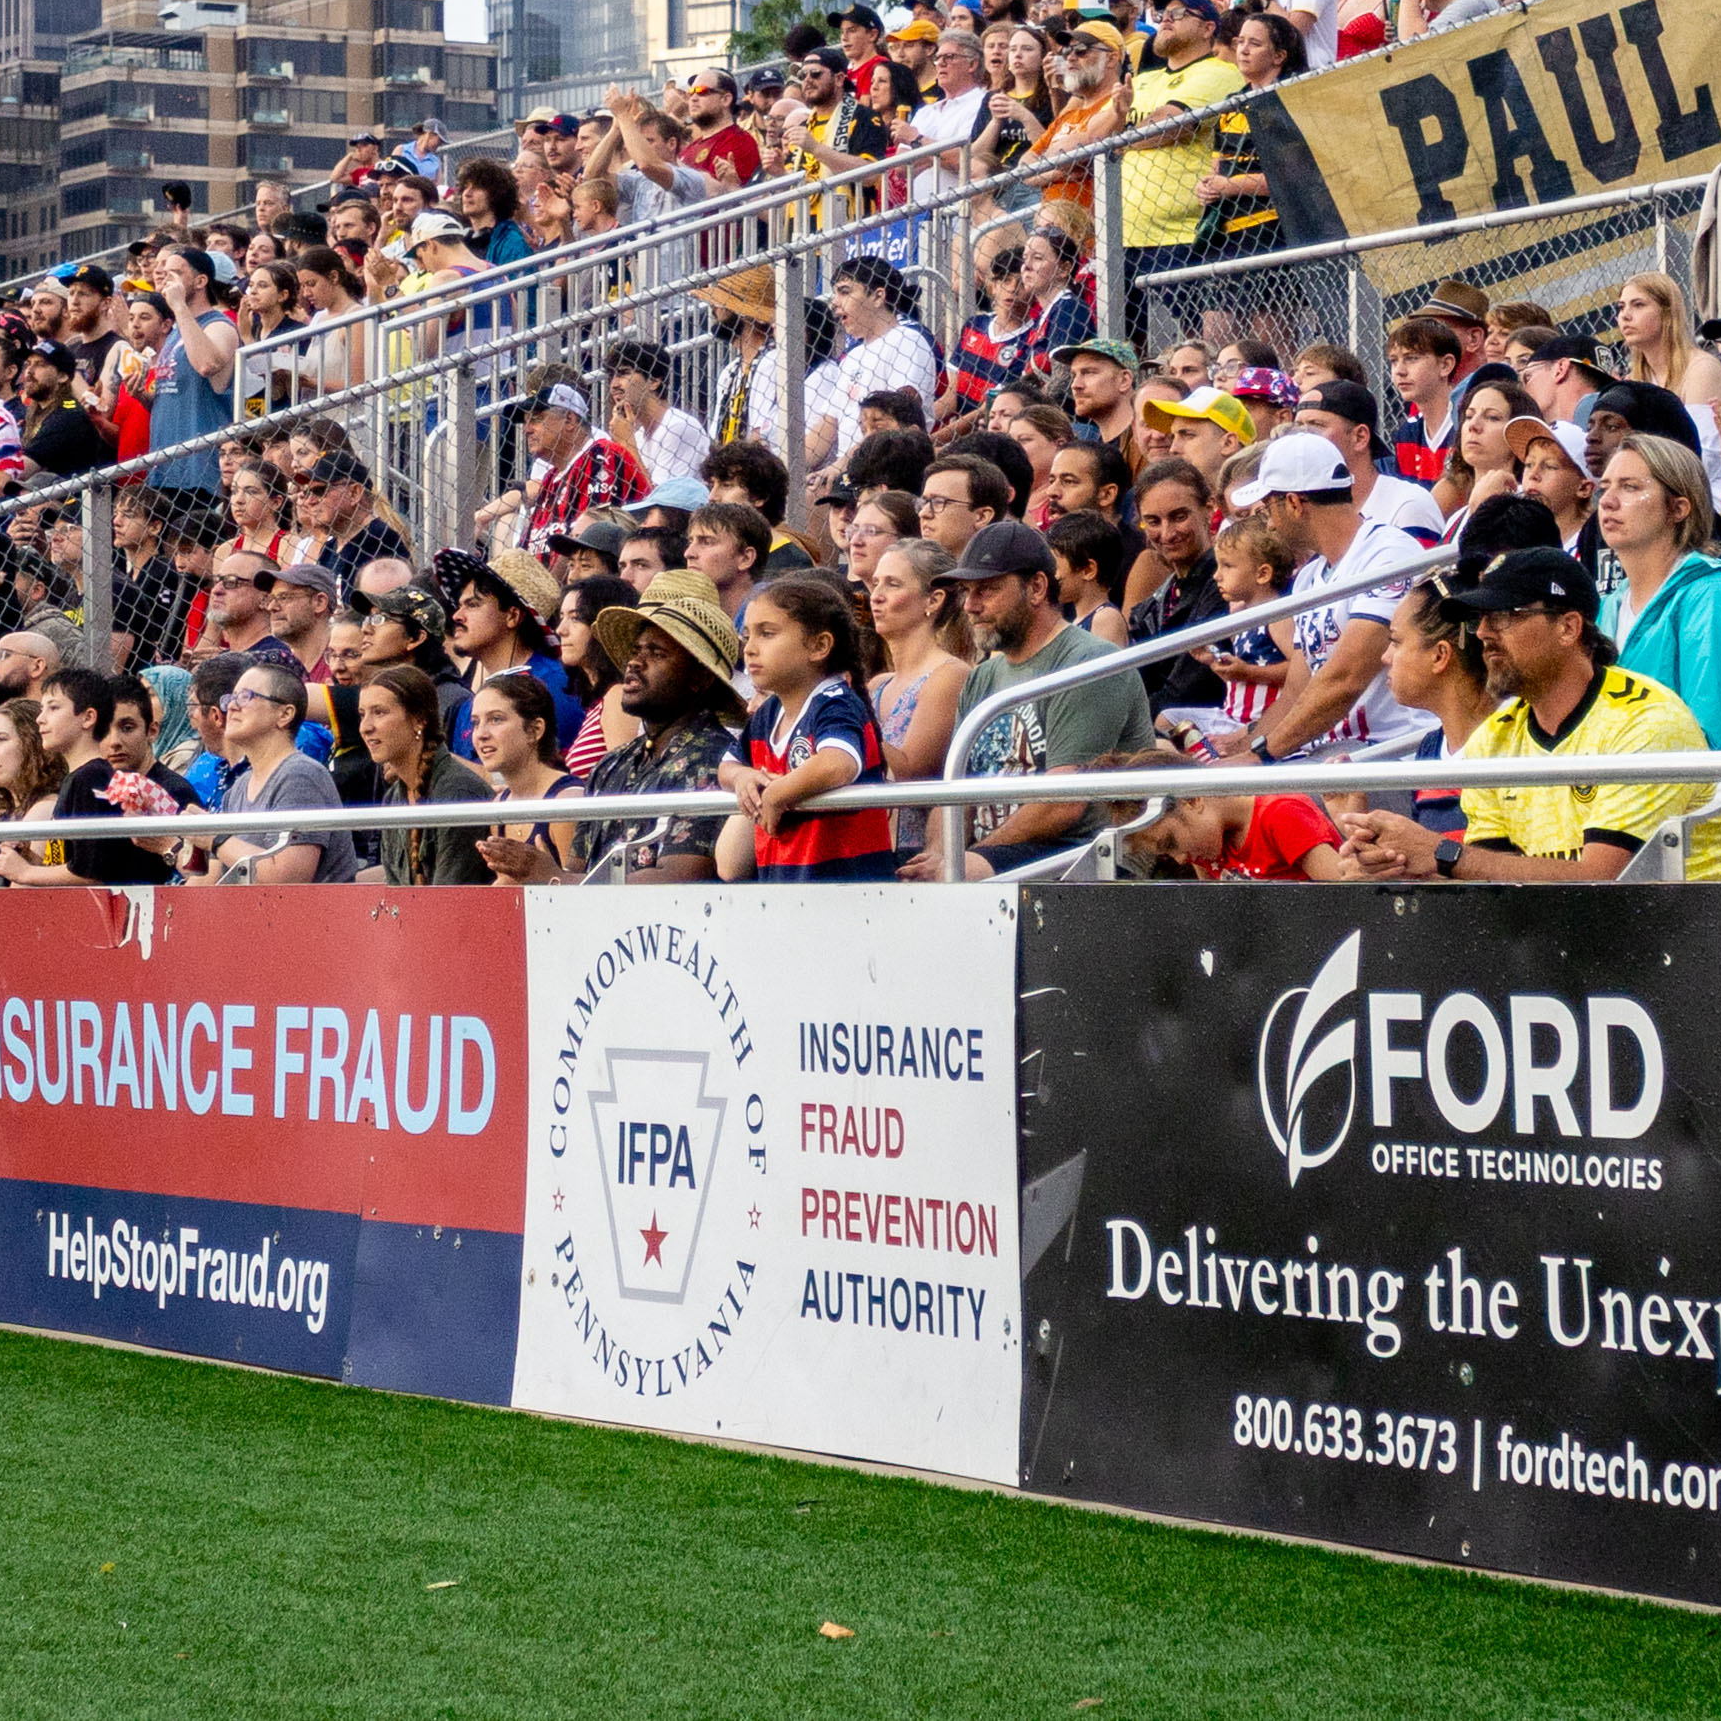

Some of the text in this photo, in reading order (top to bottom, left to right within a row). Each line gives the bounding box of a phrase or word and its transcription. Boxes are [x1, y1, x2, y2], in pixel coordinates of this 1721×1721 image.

[1015, 702, 1047, 756] ONOR
[273, 1004, 497, 1136] FRAUD
[549, 923, 768, 1175] COMMONWEALTH OF
[799, 1022, 985, 1082] INSURANCE
[1369, 991, 1664, 1140] FORD
[617, 1120, 697, 1190] IFPA
[800, 1102, 905, 1160] FRAUD
[1371, 1144, 1663, 1192] OFFICE TECHNOLOGIES
[801, 1187, 998, 1258] PREVENTION
[47, 1209, 330, 1335] HelpStopFraud.org
[800, 1268, 987, 1342] AUTHORITY
[1105, 1219, 1404, 1359] Delivering
[1425, 1246, 1519, 1340] the
[553, 1230, 757, 1398] PENNSYLVANIA
[1233, 1392, 1458, 1476] 800.633.3673
